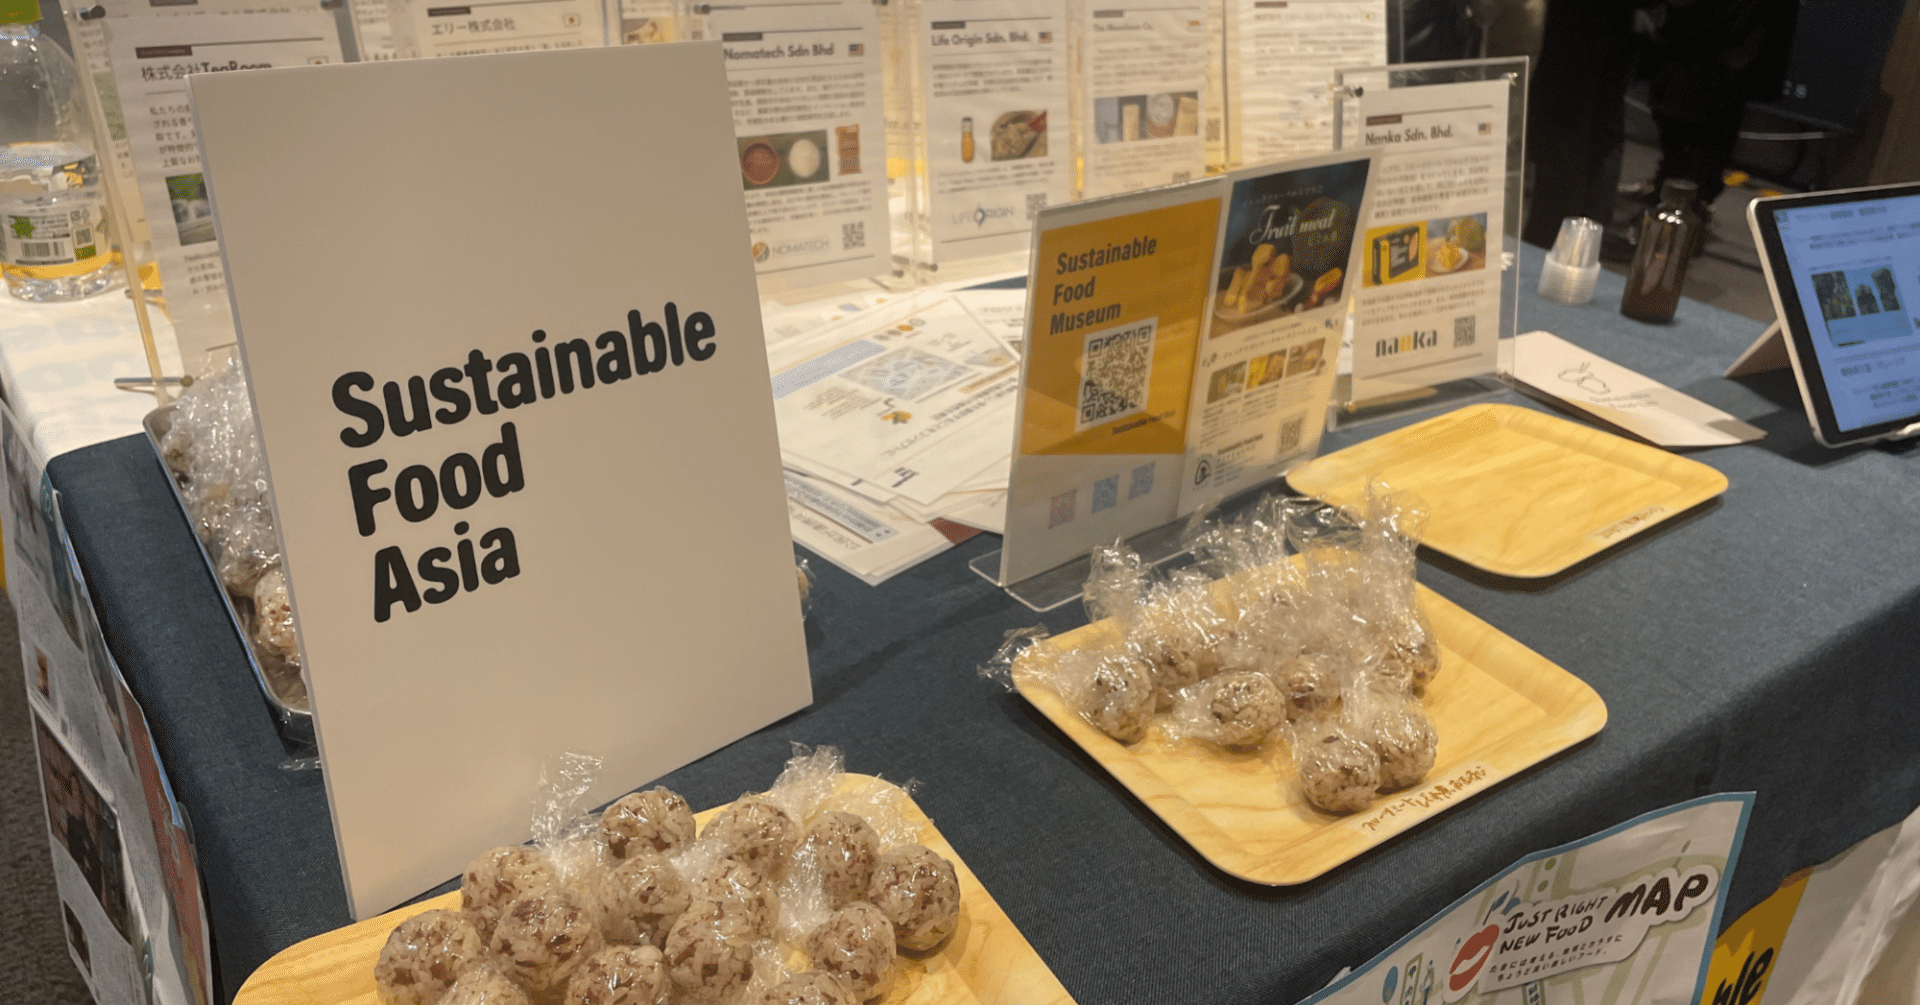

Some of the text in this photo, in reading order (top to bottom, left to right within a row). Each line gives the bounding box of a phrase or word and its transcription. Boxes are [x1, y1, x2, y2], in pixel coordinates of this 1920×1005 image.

[432, 18, 516, 35] エリー株式会社
[931, 31, 1030, 48] Life Origin Sdn. Bhd.
[723, 44, 835, 61] Nomatech Sdn Bhd
[1365, 127, 1401, 146] Nanka
[1404, 126, 1429, 142] Sdn.
[1430, 124, 1453, 141] Bhd.
[1249, 204, 1297, 245] Fruit
[771, 239, 830, 256] NOMATECH
[1056, 235, 1157, 275] Sustainable
[1053, 275, 1096, 306] Food
[1049, 302, 1122, 336] Museum
[332, 301, 717, 448] Sustainable
[348, 421, 525, 537] Food
[374, 521, 521, 623] Asia
[1555, 894, 1609, 925] RIGHT
[1604, 873, 1709, 924] MAP
[1500, 930, 1540, 954] NEW
